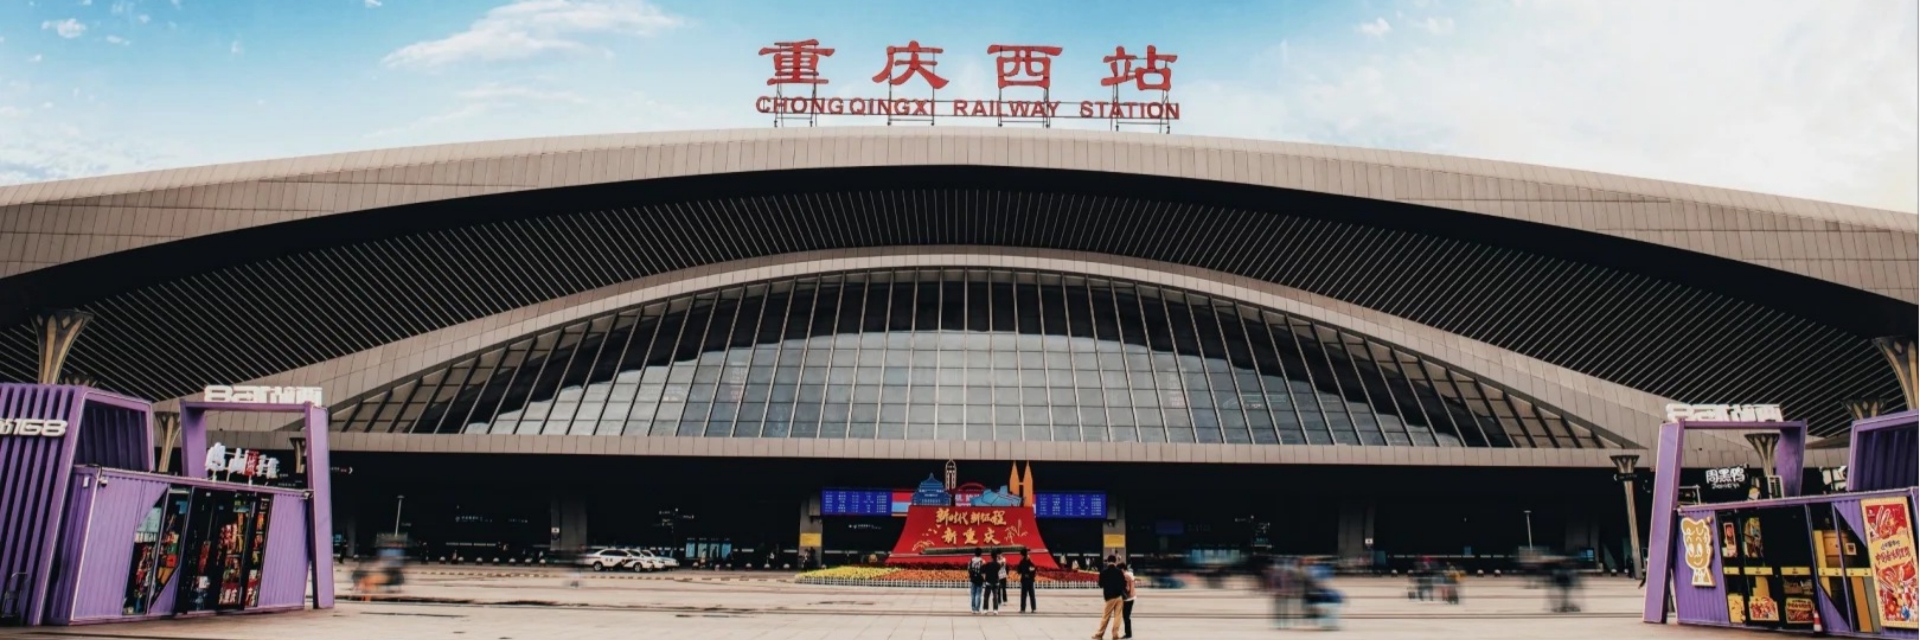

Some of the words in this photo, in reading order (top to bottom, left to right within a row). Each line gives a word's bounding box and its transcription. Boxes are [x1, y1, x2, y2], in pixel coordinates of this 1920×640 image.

[758, 38, 1178, 91] 重庆西站
[953, 99, 1061, 118] RAILWAY
[1079, 101, 1180, 120] STATION
[1705, 466, 1745, 484] 周黑鸭
[941, 526, 1001, 545] 新重庆
